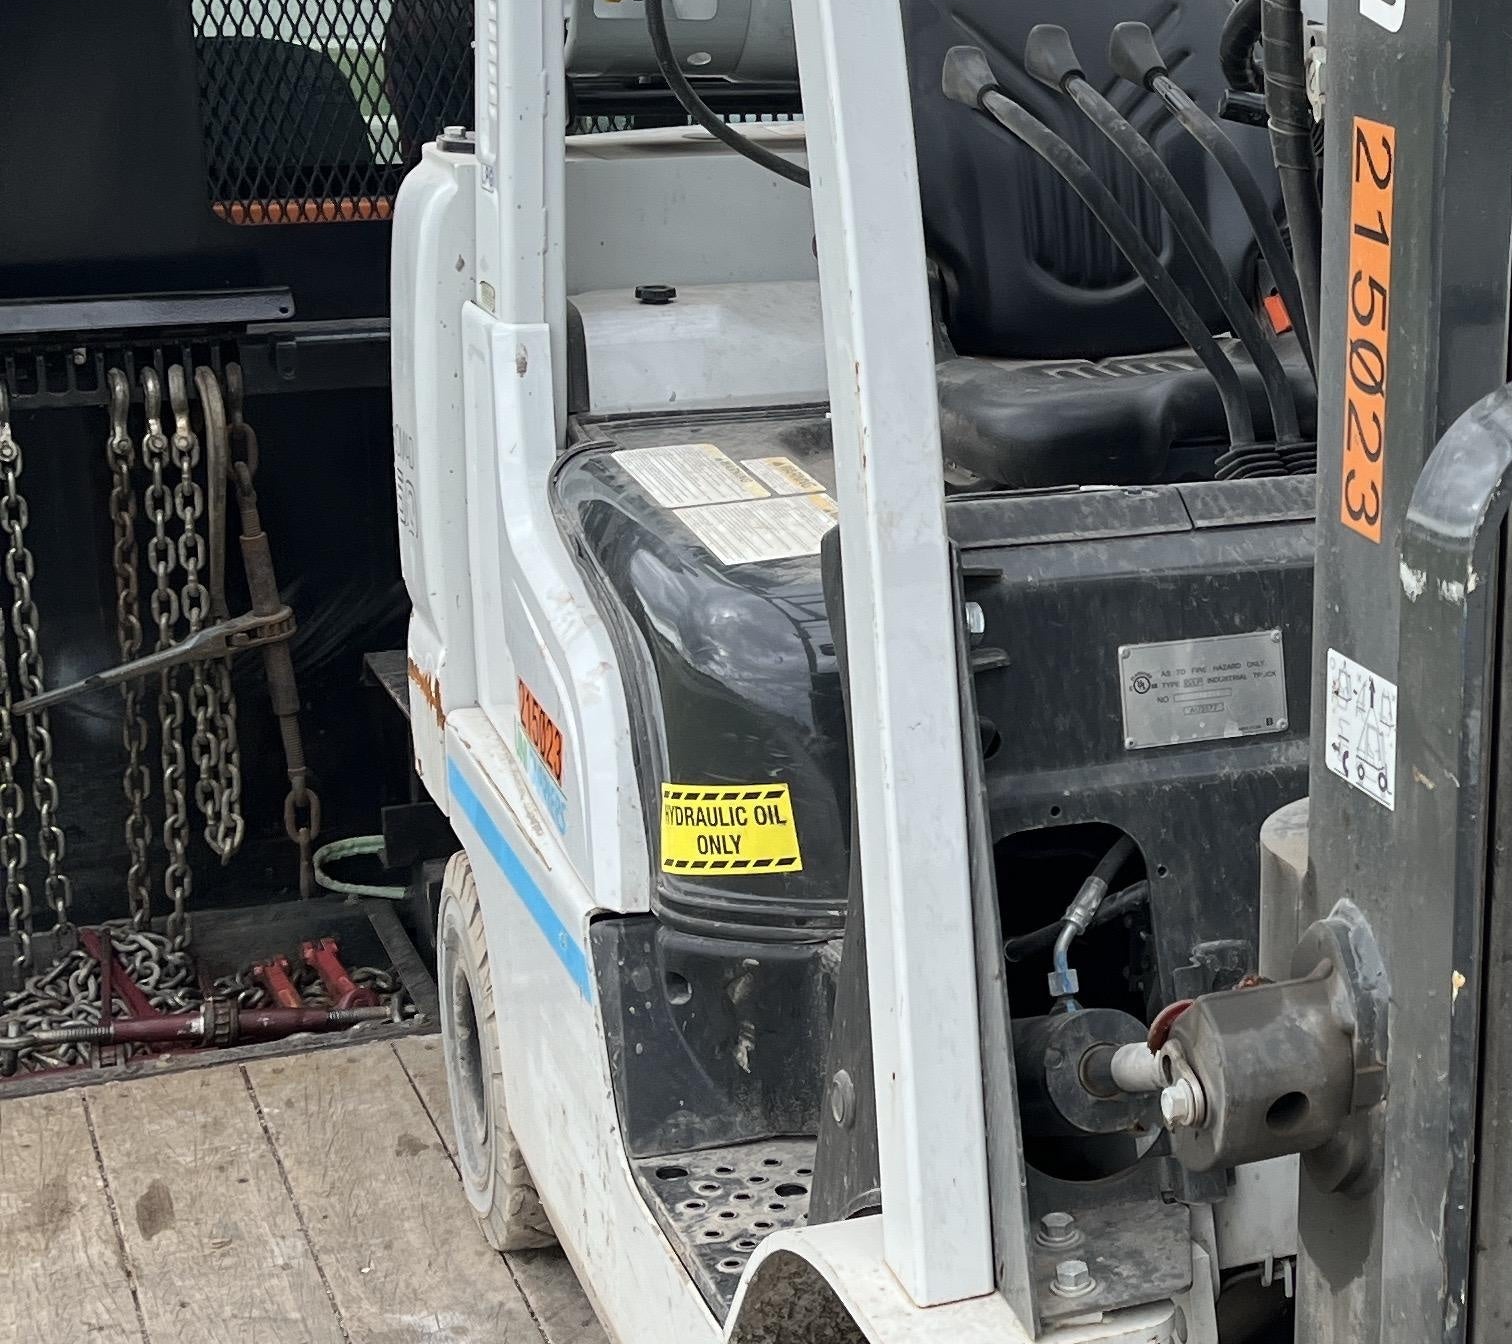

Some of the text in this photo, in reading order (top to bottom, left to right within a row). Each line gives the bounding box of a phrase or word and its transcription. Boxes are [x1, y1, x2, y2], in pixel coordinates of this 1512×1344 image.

[1344, 124, 1396, 530] 215023
[753, 804, 787, 826] OIL
[696, 834, 742, 855] ONLY
